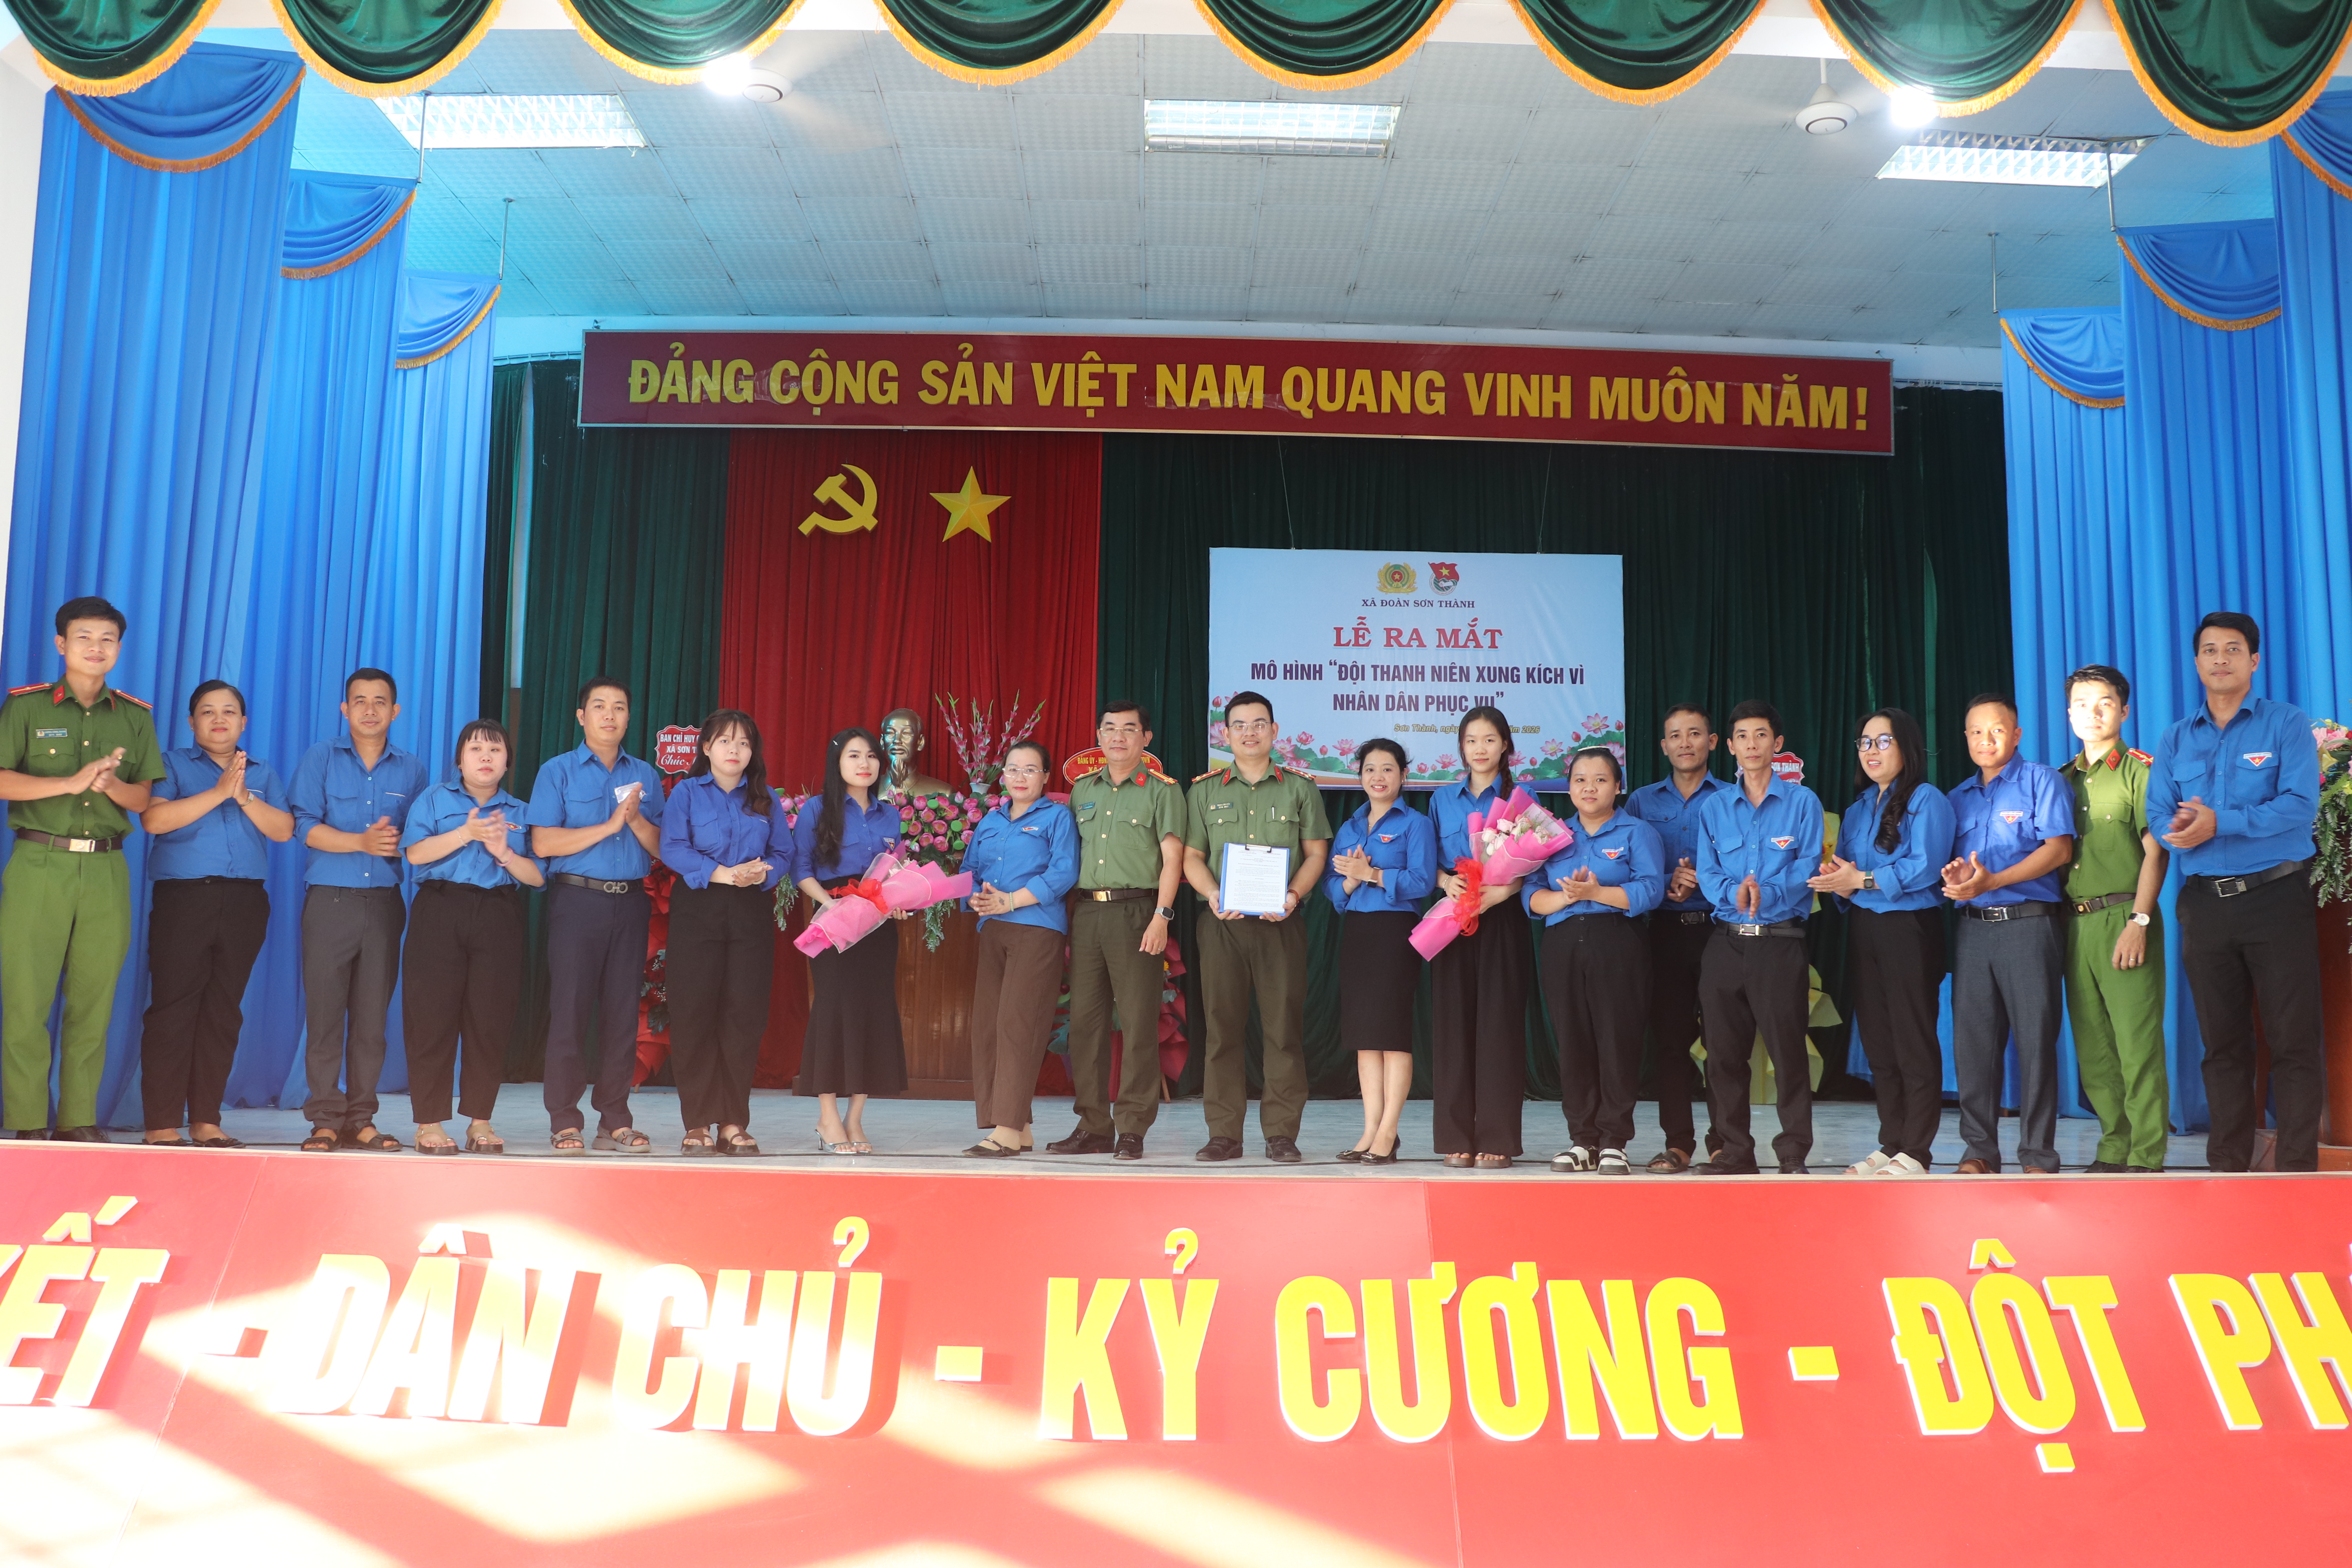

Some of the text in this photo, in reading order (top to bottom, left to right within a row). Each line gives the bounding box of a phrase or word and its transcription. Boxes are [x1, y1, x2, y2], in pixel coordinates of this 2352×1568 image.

[629, 342, 754, 404] ĐẢNG
[770, 348, 899, 416] CỘNG
[918, 343, 1013, 406] SẢN
[1031, 351, 1137, 418] VIỆT
[1156, 364, 1265, 410] NAM
[1281, 365, 1446, 419] QUANG
[1464, 372, 1572, 418] VINH
[1590, 366, 1725, 424] MUÔN
[1362, 598, 1475, 608] XÃ ĐOÀN SƠN THÀNH
[1334, 616, 1503, 649] LỄ RA MẮT
[1251, 660, 1278, 681] MÔ
[1283, 660, 1323, 681] HÌNH
[1371, 664, 1426, 682] THANH
[1431, 662, 1471, 683] NIÊN
[1476, 666, 1521, 684] XUNG
[1526, 663, 1564, 685] KÍCH
[1569, 664, 1584, 685] VÌ
[1333, 691, 1379, 711] NHÂN
[1386, 691, 1419, 712] DÂN
[1425, 695, 1468, 715] PHỤC
[1412, 724, 1438, 733] Thành,
[1440, 724, 1460, 734] ngày
[1521, 725, 1541, 733] 2026
[660, 734, 671, 742] BAN
[673, 732, 682, 742] CHỈ
[684, 734, 696, 743] HUY
[666, 744, 676, 753] XÃ
[677, 745, 690, 753] SƠN
[661, 754, 685, 765] Chúc
[1077, 755, 1089, 764] ĐẢNG
[1089, 755, 1095, 764] ỦY
[0, 1196, 171, 1406] ẾT
[270, 1223, 577, 1424] DÂN
[612, 1216, 883, 1436] CHỦ
[1040, 1228, 1220, 1441] KỶ
[1274, 1261, 1744, 1443] CƯƠNG
[1882, 1238, 2146, 1472] ĐỘT
[2168, 1254, 2352, 1430] PH
